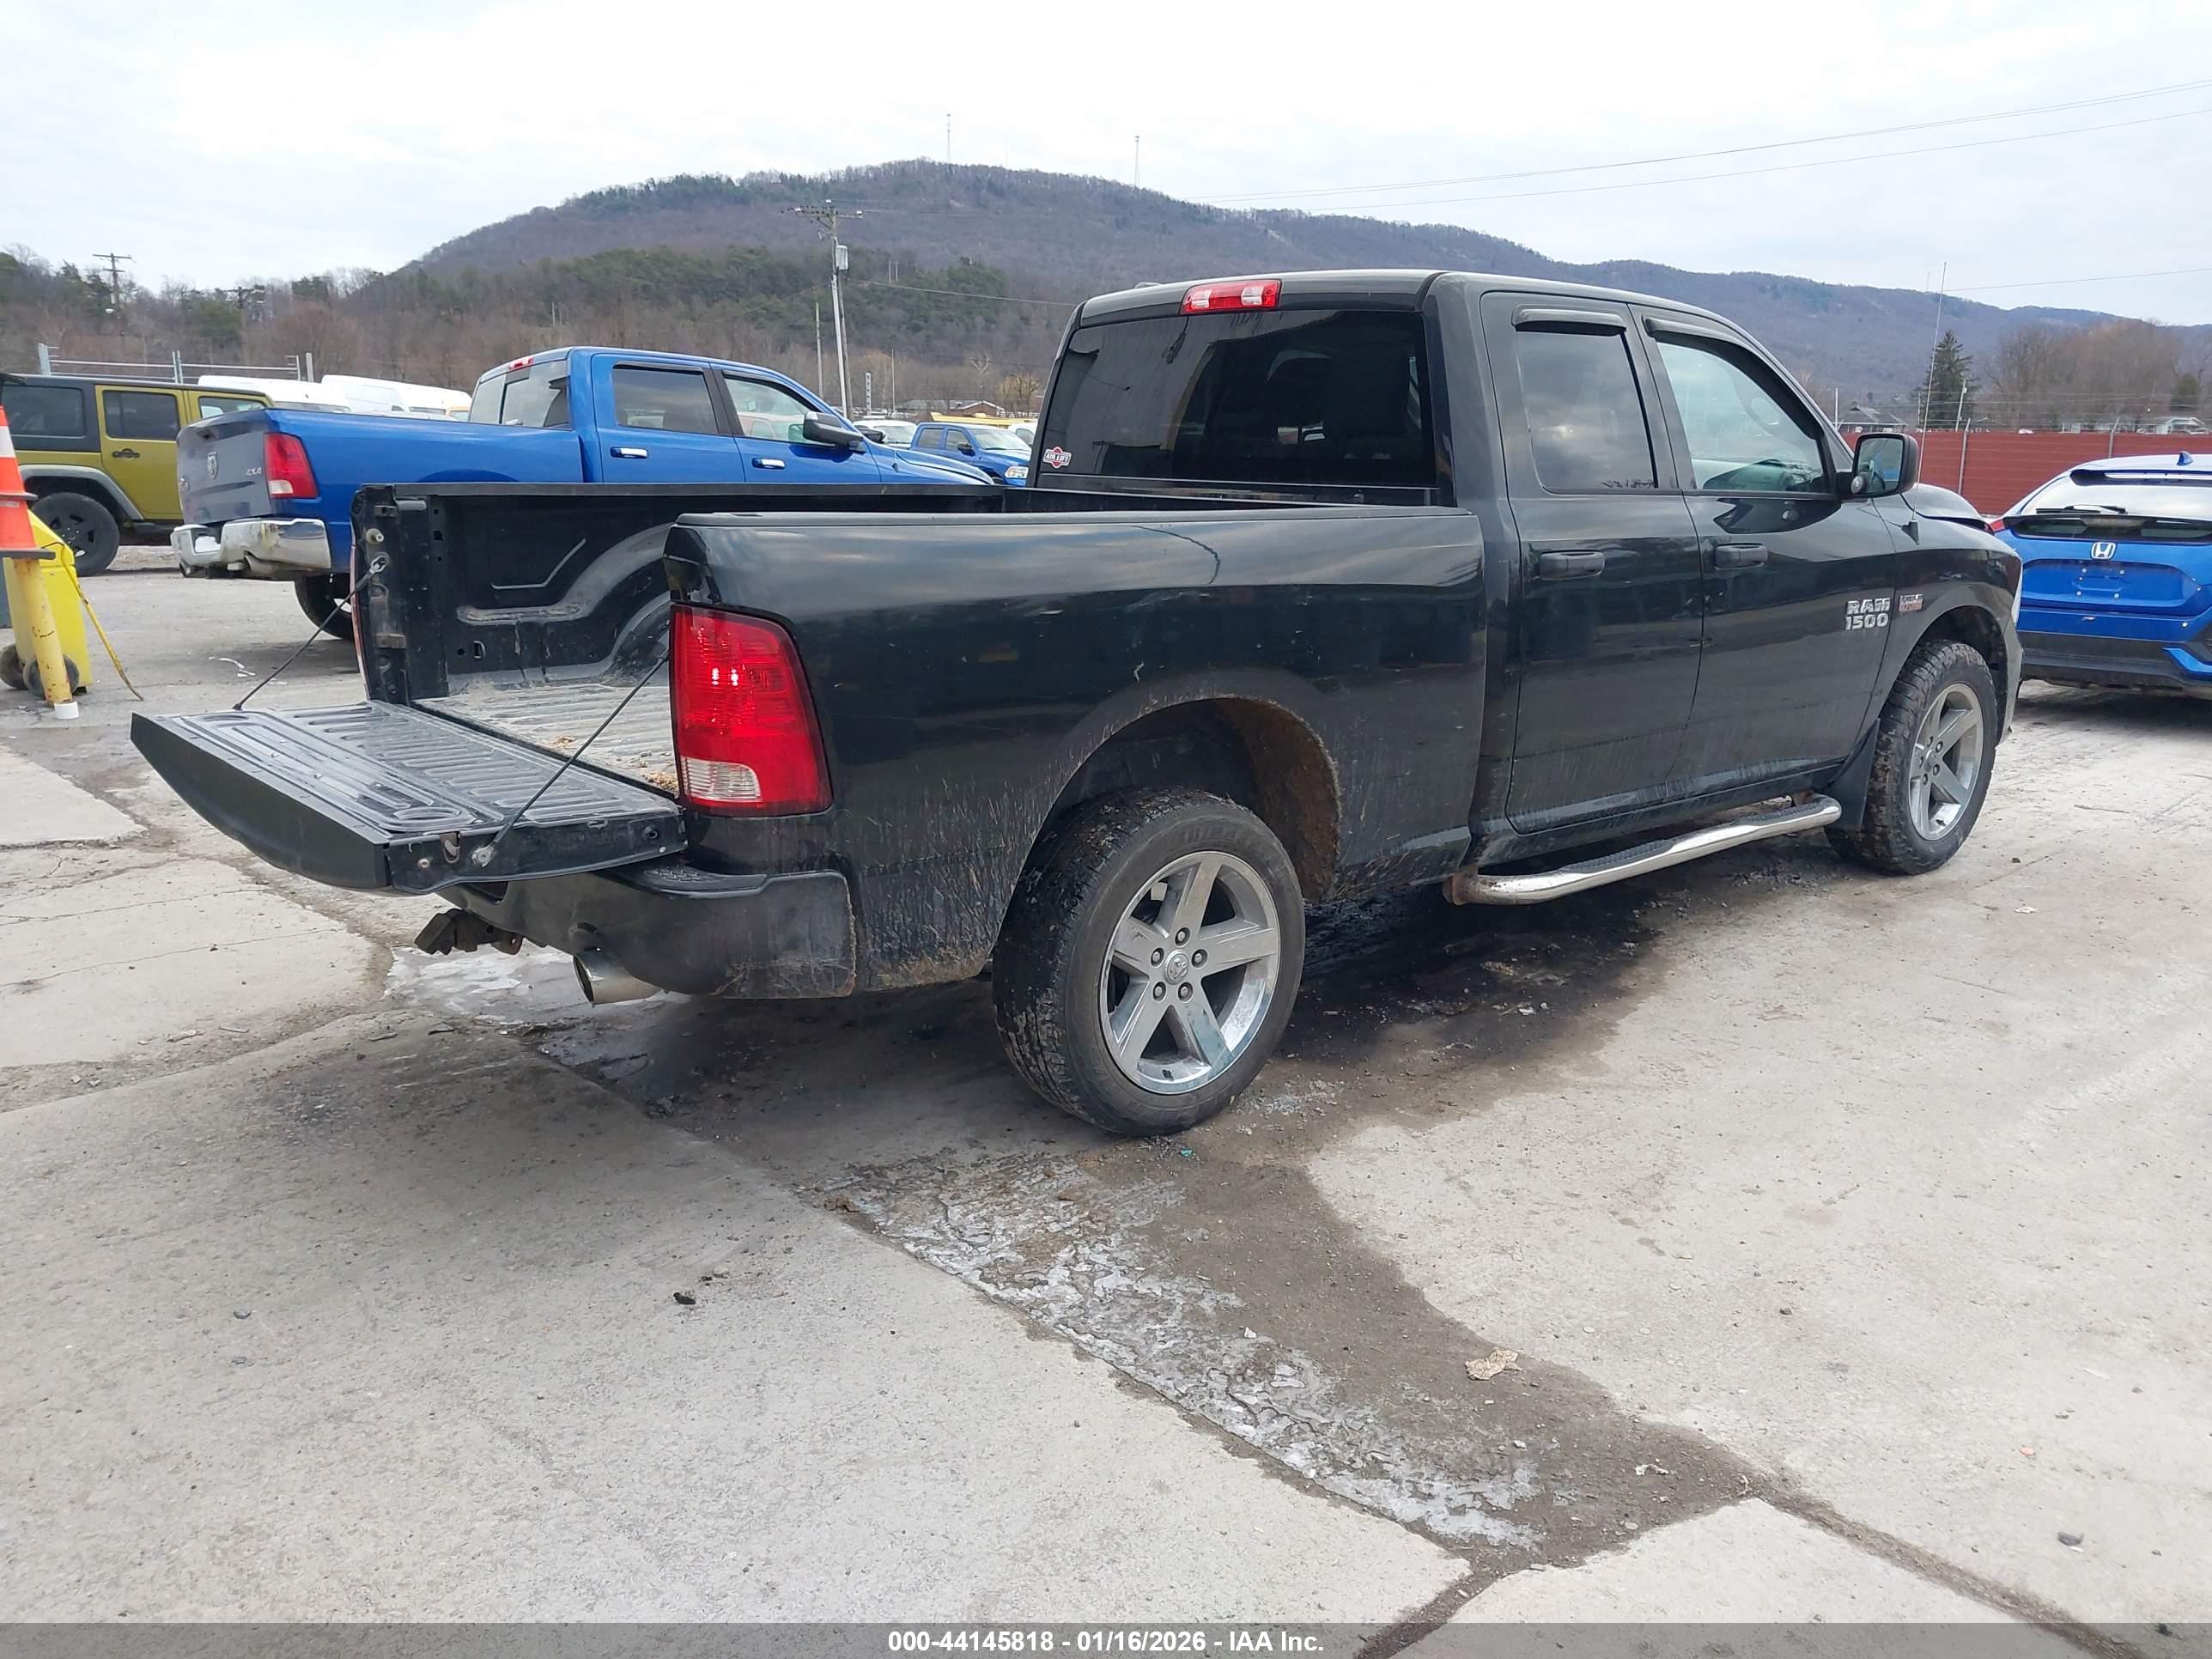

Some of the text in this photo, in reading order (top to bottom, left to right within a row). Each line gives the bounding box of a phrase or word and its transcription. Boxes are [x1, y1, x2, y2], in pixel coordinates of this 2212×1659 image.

[1045, 452, 1069, 463] AIR LIFT
[1846, 598, 1891, 615] RAM
[1845, 613, 1889, 630] 1500
